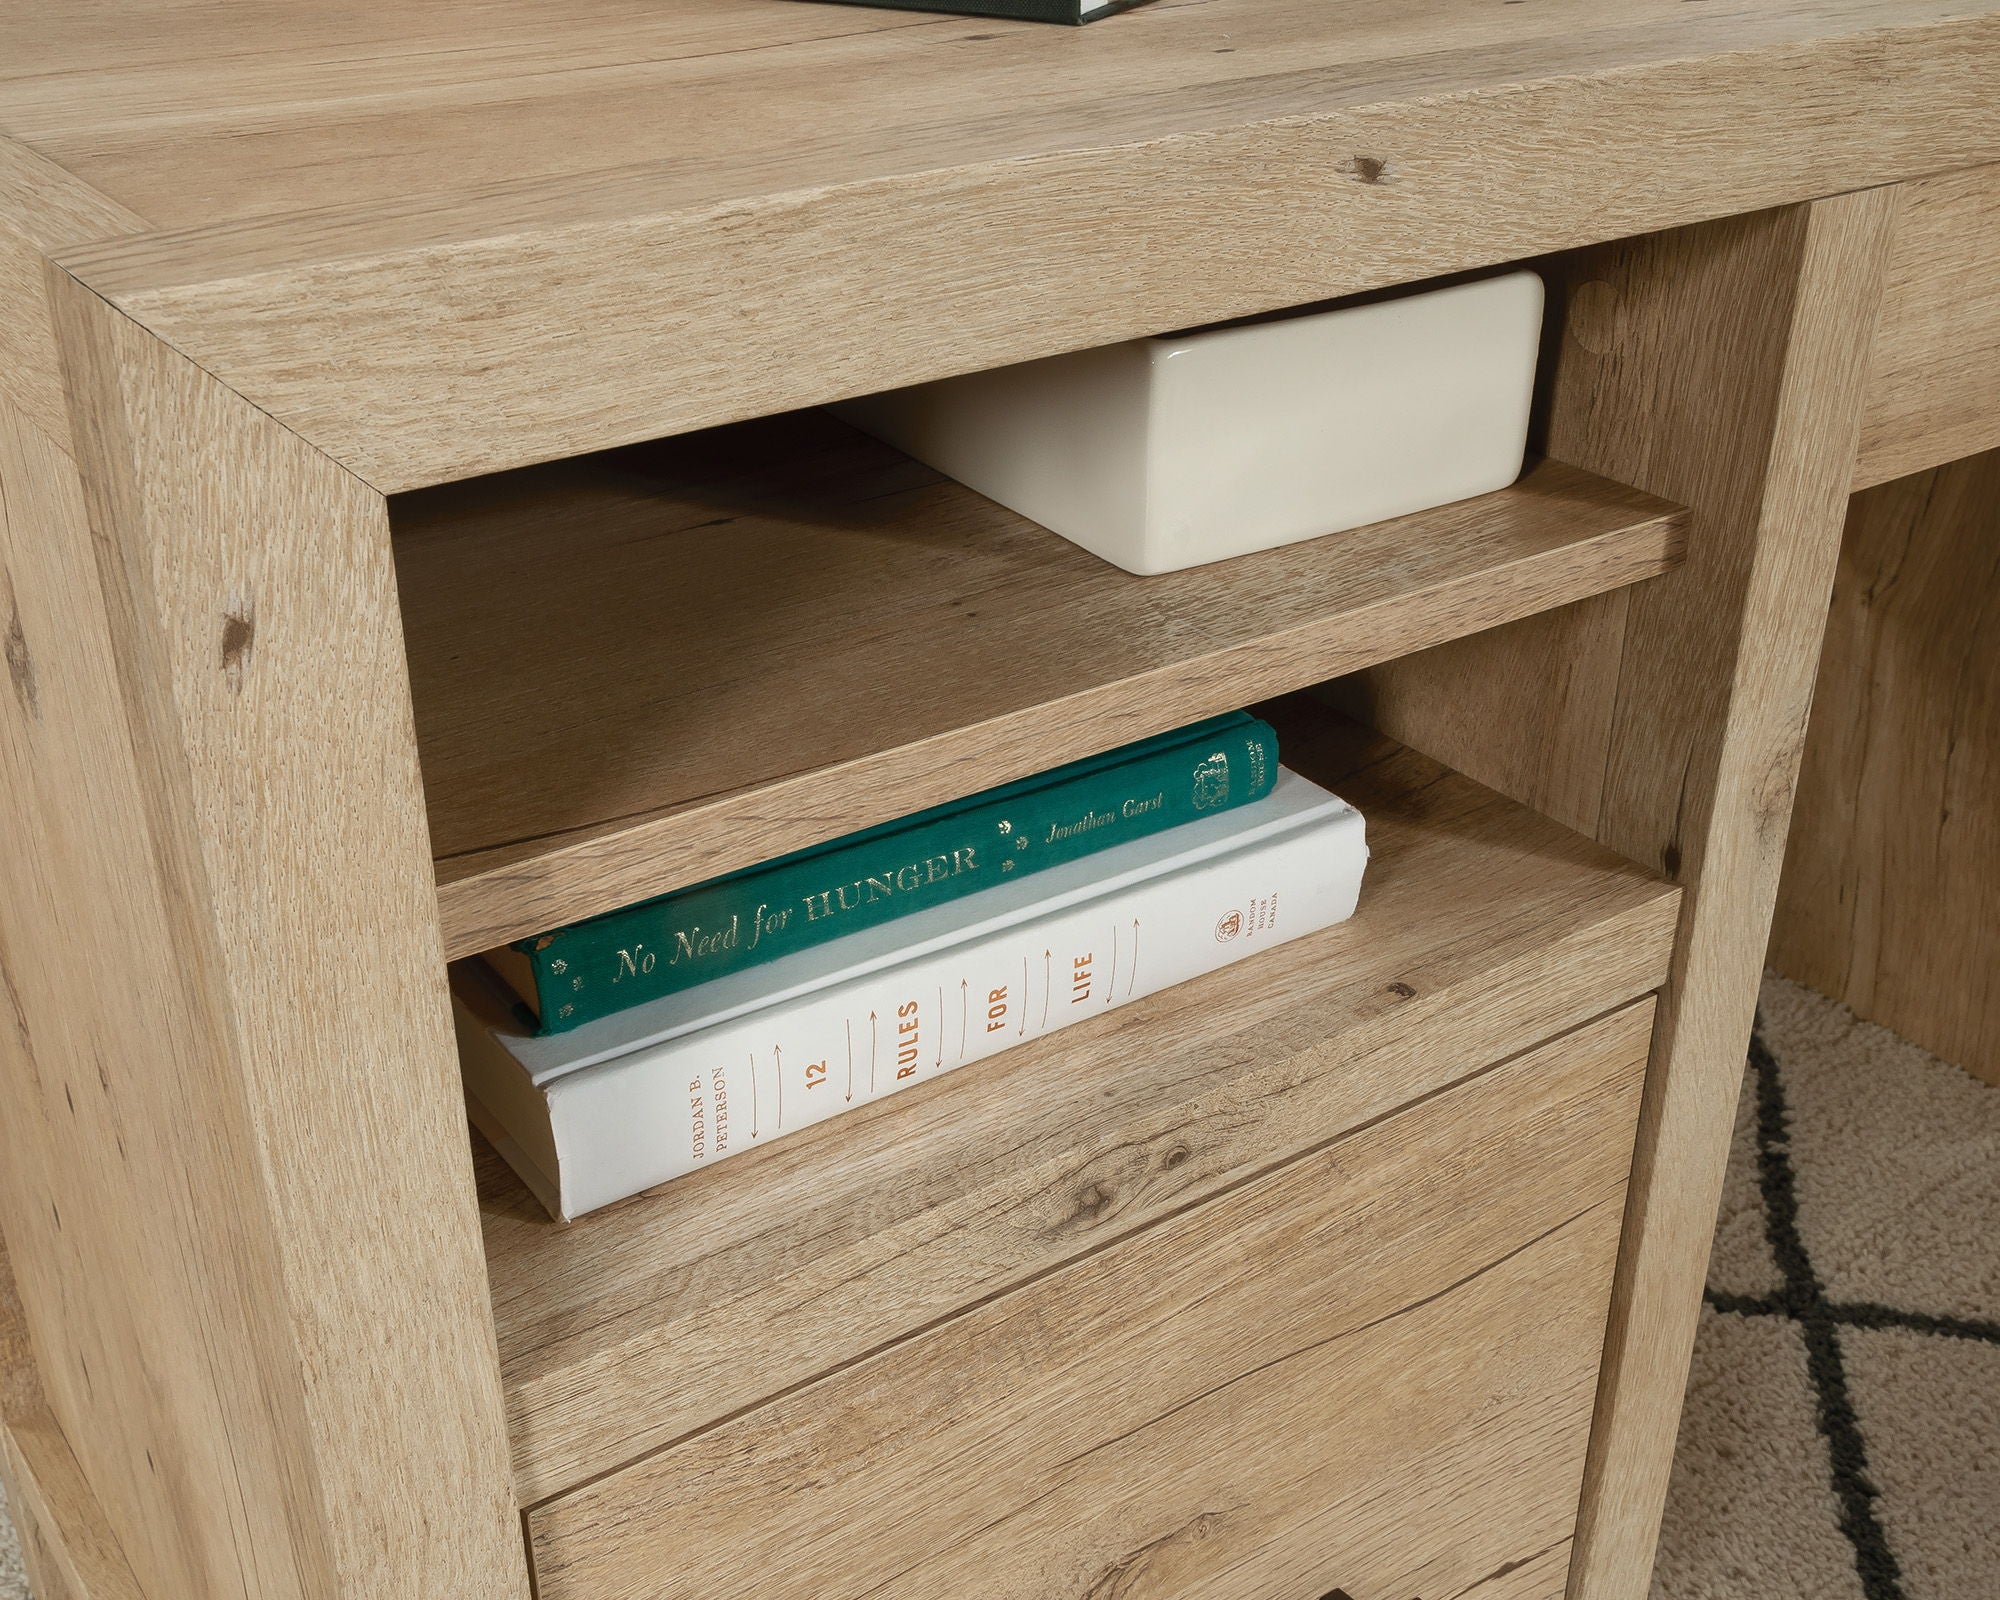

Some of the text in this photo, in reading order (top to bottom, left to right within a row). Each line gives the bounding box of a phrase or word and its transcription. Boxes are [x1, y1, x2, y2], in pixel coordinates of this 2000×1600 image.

[1045, 792, 1163, 844] Jonathan Garst
[612, 847, 980, 984] No Need for HUNGER
[1246, 898, 1257, 938] RANDOM
[1258, 899, 1268, 930] HOUSE
[1267, 891, 1278, 930] CANADA
[1071, 952, 1092, 1004] LIFE
[987, 985, 1008, 1032] FOR
[896, 1000, 919, 1081] RULES
[805, 1060, 827, 1090] 12
[689, 1074, 705, 1160] JORDAN B.
[711, 1066, 728, 1153] PETERSON
